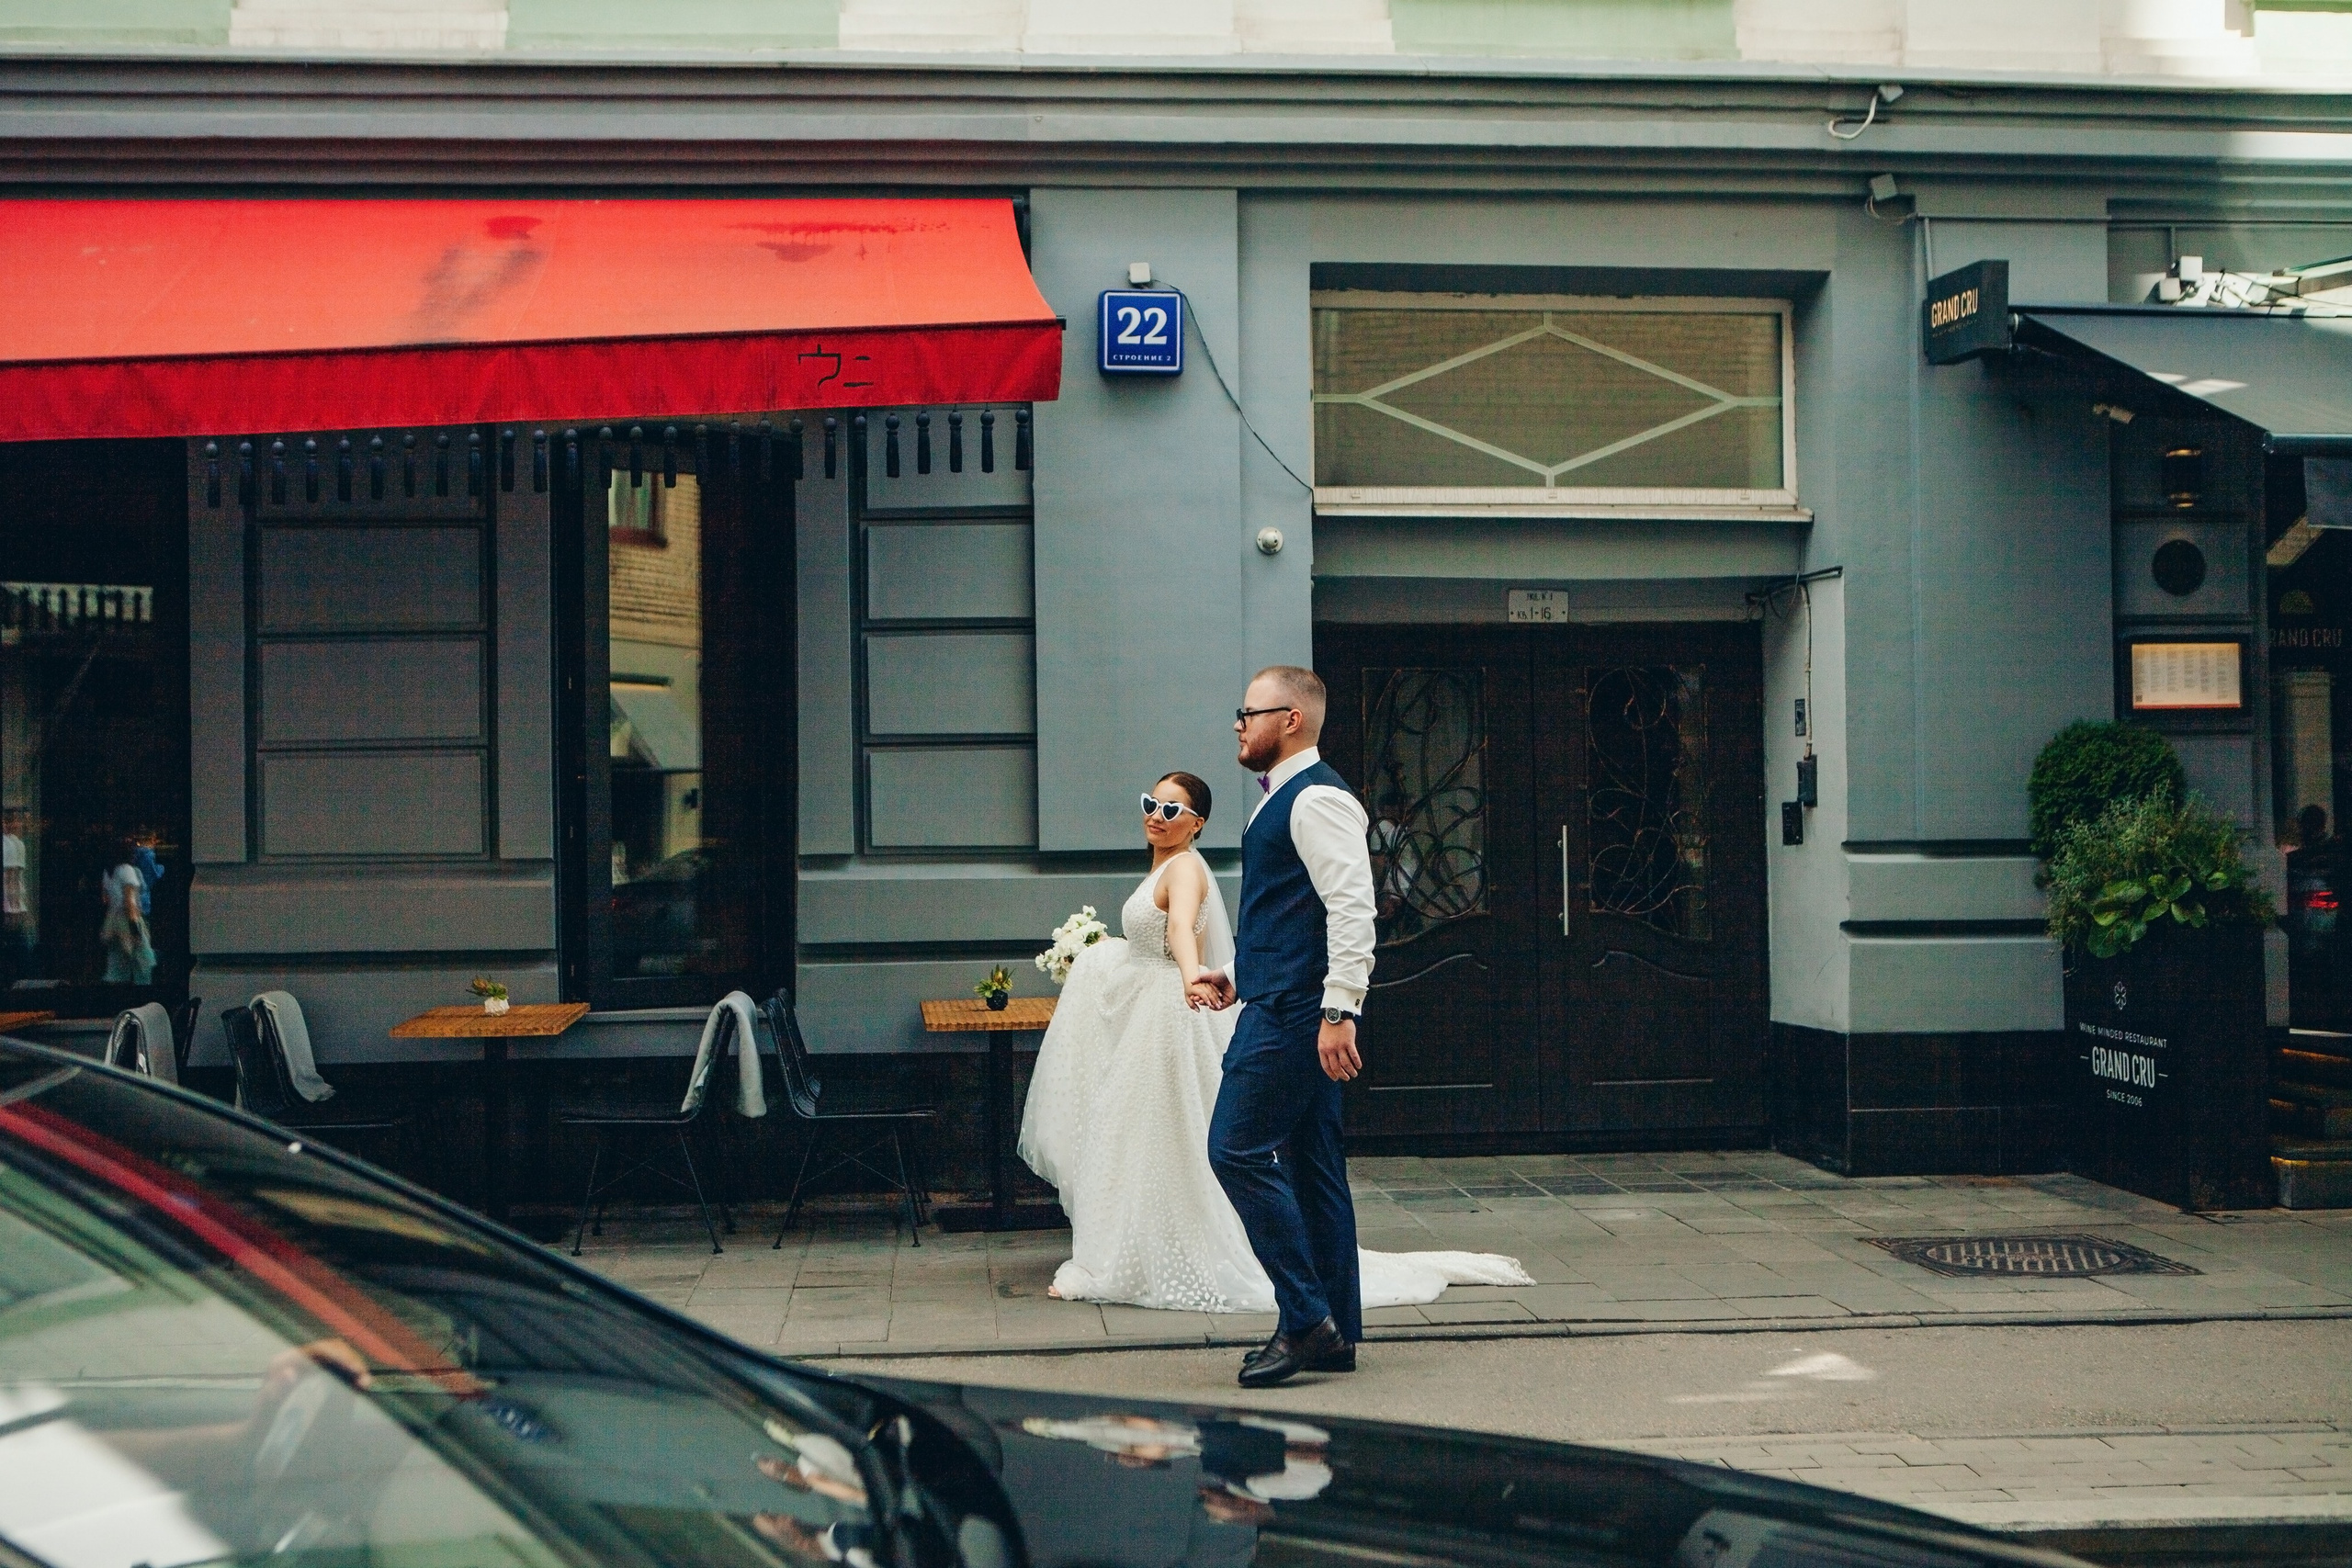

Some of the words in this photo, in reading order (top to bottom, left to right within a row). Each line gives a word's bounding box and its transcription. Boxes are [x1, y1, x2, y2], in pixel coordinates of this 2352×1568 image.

[1931, 294, 1960, 329] GRAND
[1961, 288, 1978, 318] CRU
[1117, 306, 1168, 345] 22
[2268, 628, 2308, 647] RAND
[2312, 628, 2343, 647] CRU
[2079, 1021, 2096, 1034] WINE
[2098, 1026, 2123, 1040] MINDED
[2124, 1031, 2167, 1048] RESTAURANT
[2092, 1045, 2130, 1082] GRAND
[2132, 1054, 2155, 1089] CRU
[2106, 1089, 2125, 1102] SINCE
[2126, 1094, 2143, 1107] 2006
